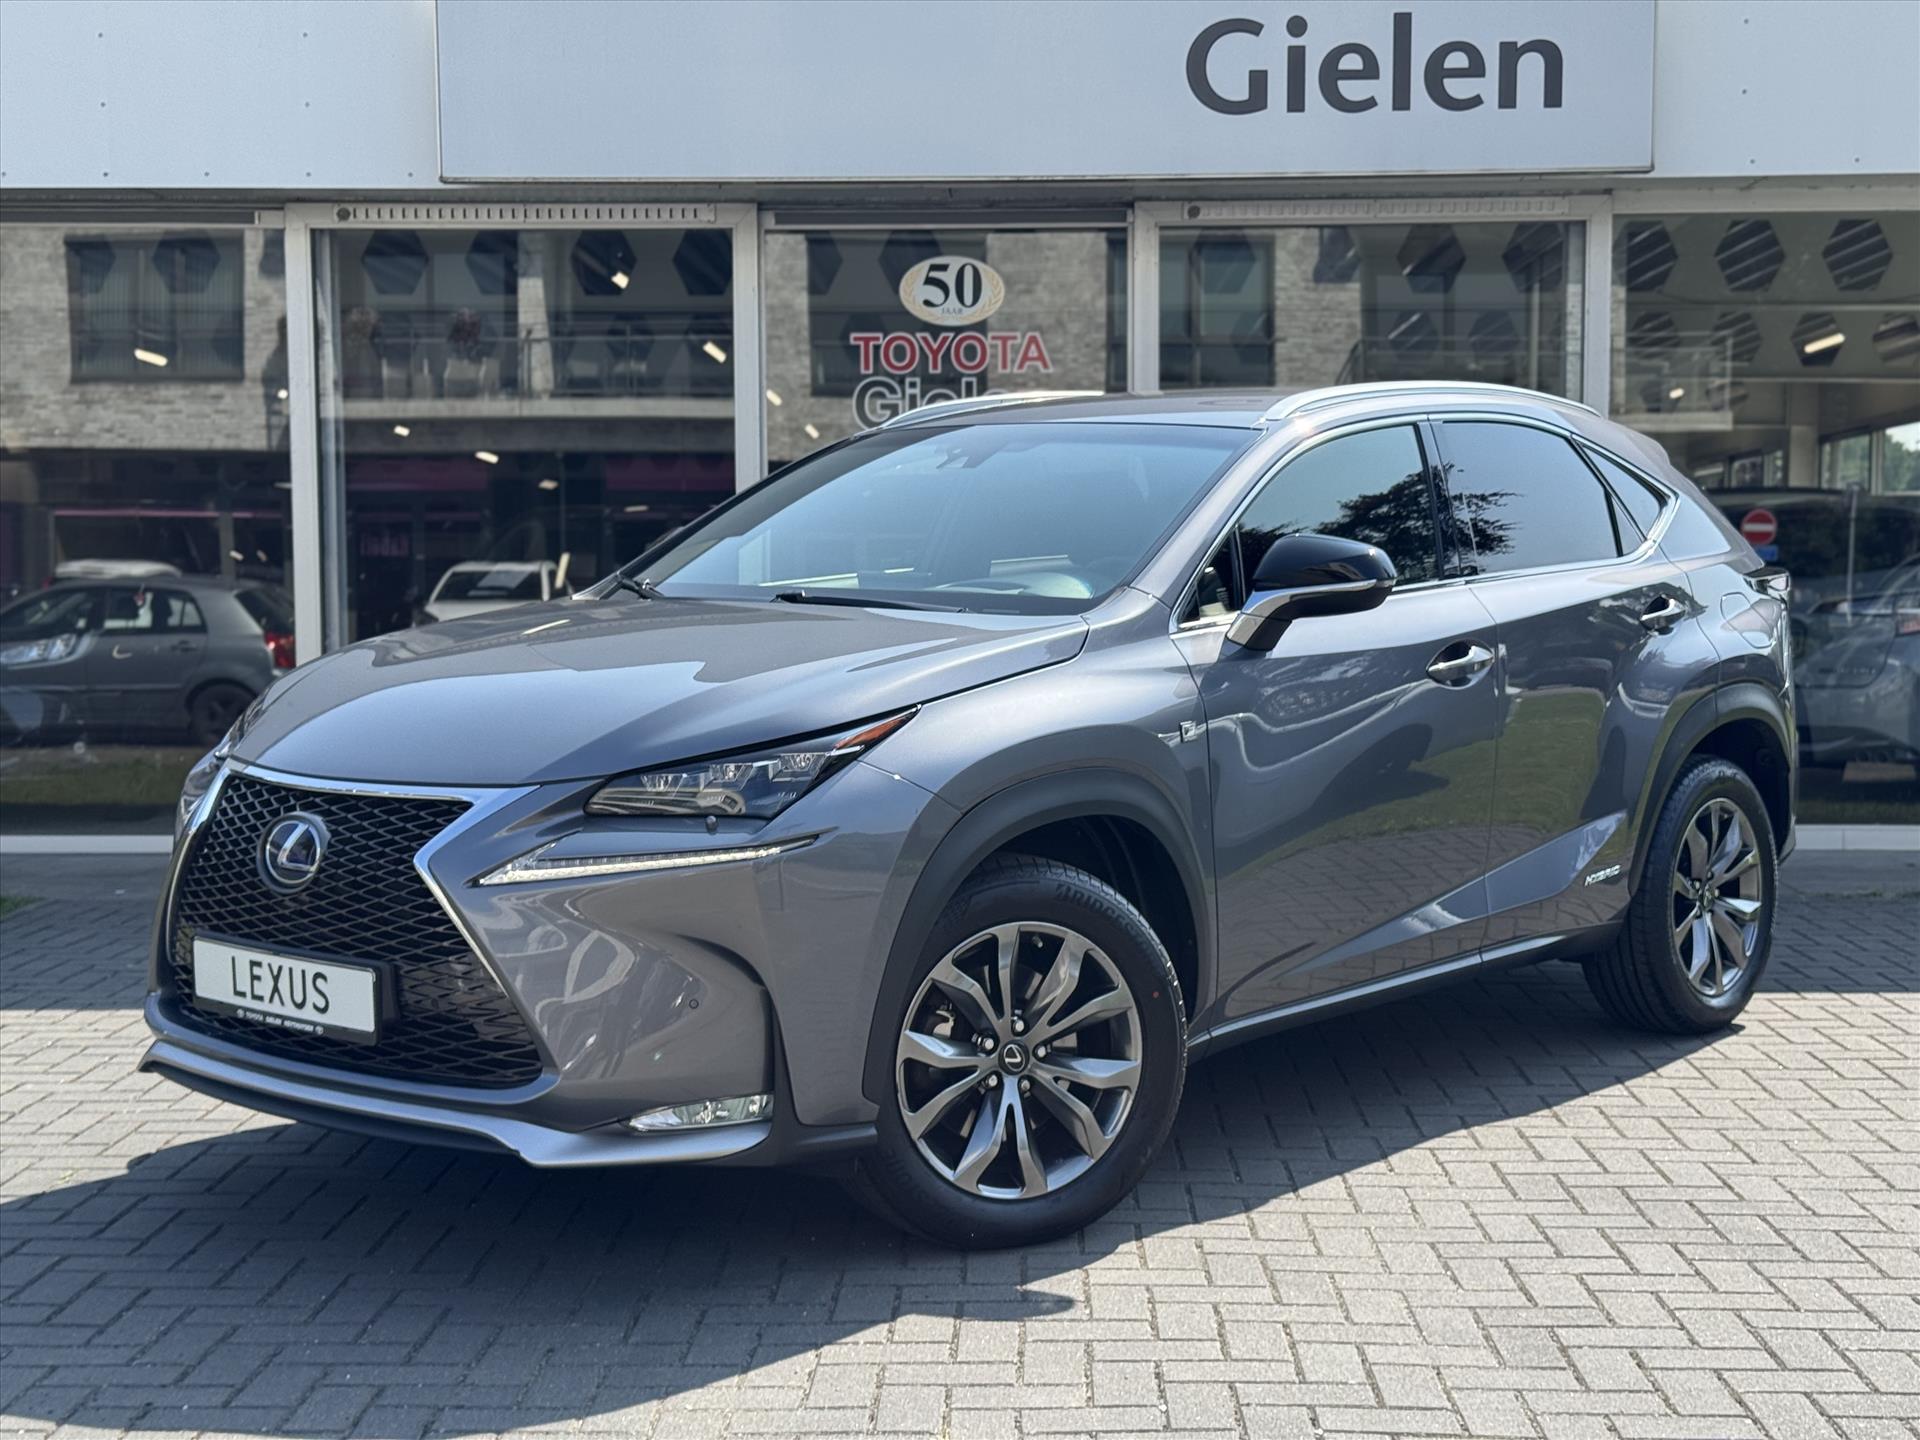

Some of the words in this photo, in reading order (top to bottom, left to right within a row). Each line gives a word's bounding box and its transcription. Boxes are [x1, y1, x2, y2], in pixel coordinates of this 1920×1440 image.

[1186, 12, 1563, 115] Gielen
[922, 263, 982, 308] 50
[851, 334, 1052, 373] TOYOTA
[231, 956, 330, 1014] LEXUS
